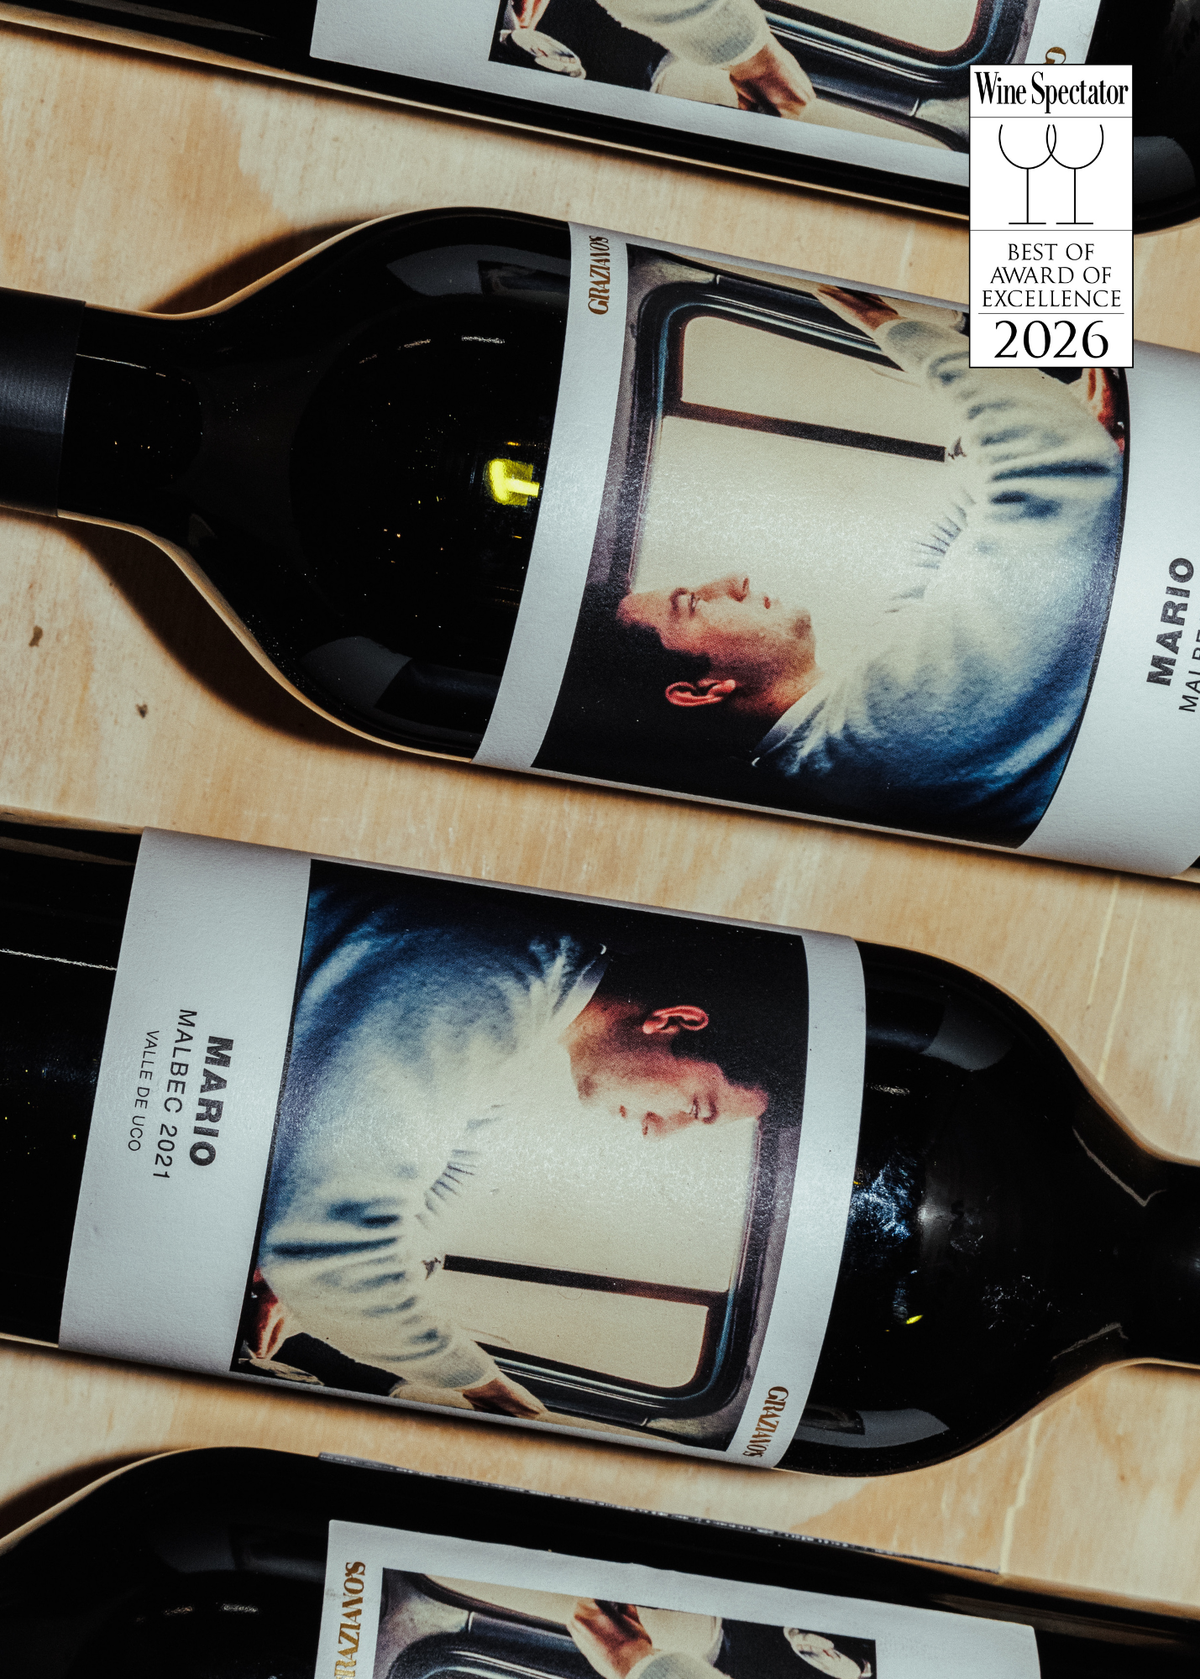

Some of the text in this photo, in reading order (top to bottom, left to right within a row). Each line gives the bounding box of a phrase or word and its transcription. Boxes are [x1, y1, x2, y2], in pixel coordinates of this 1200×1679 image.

[1146, 557, 1195, 687] MARIO
[1178, 627, 1200, 713] MAL
[128, 1030, 160, 1152] VALLE DE UCO
[153, 1009, 198, 1179] MALBEC 2021
[189, 1035, 234, 1167] MARIO
[333, 1561, 366, 1679] RAZIANO'S
